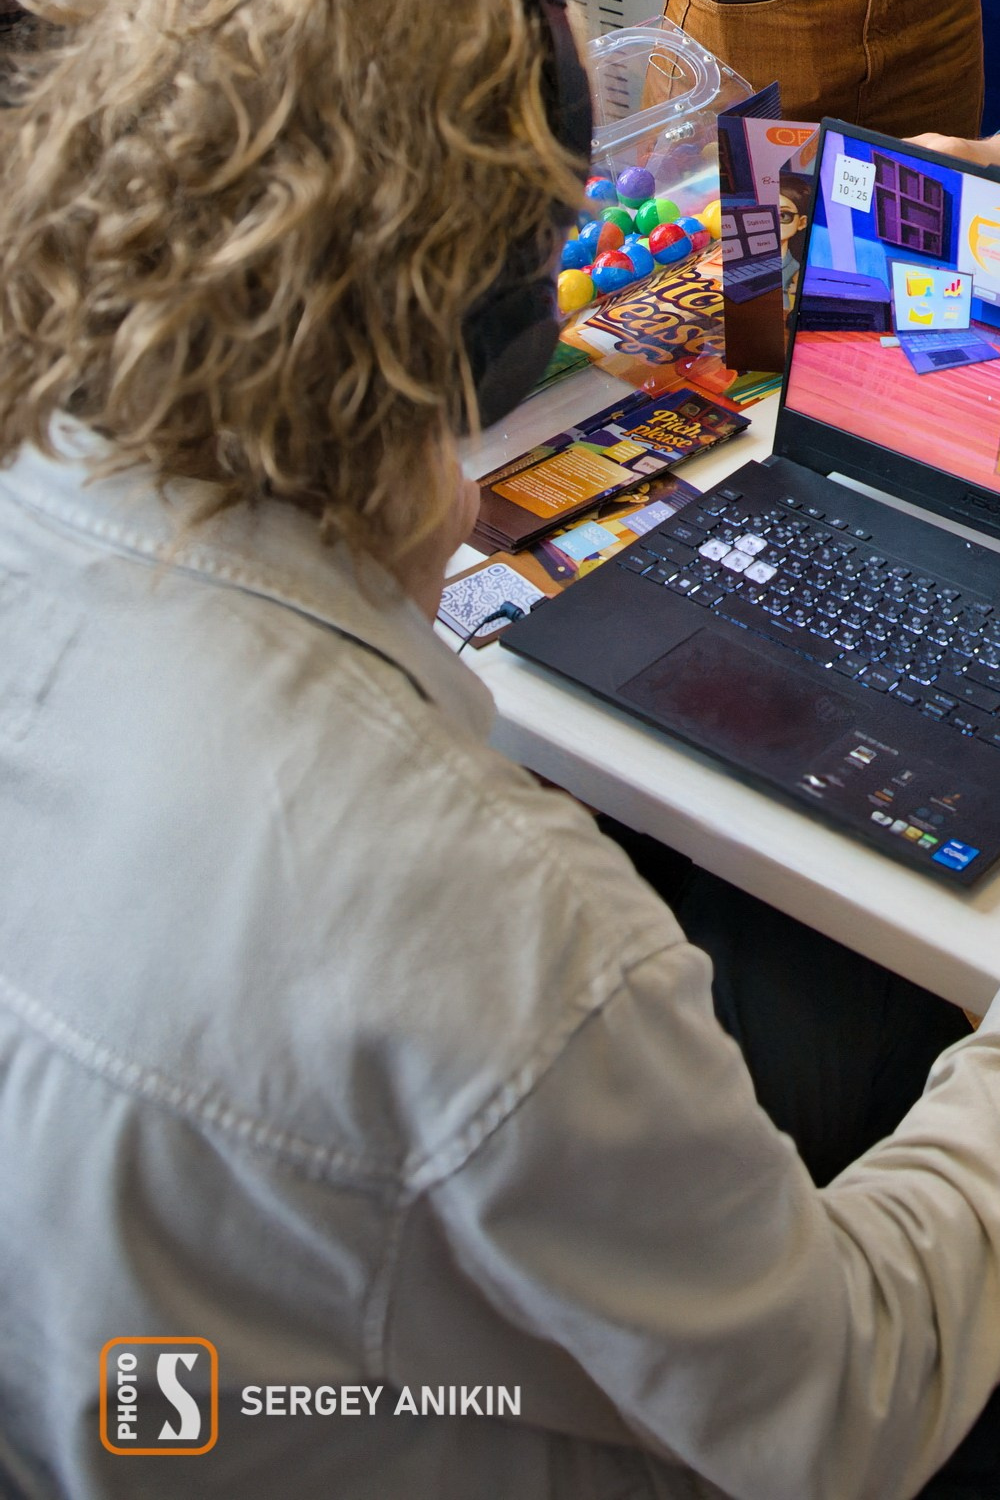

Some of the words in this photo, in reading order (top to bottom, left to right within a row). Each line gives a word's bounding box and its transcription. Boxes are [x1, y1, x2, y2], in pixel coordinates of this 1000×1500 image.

[842, 171, 860, 186] Day
[862, 177, 867, 187] 1
[646, 409, 702, 439] Pitch,
[622, 425, 693, 449] please
